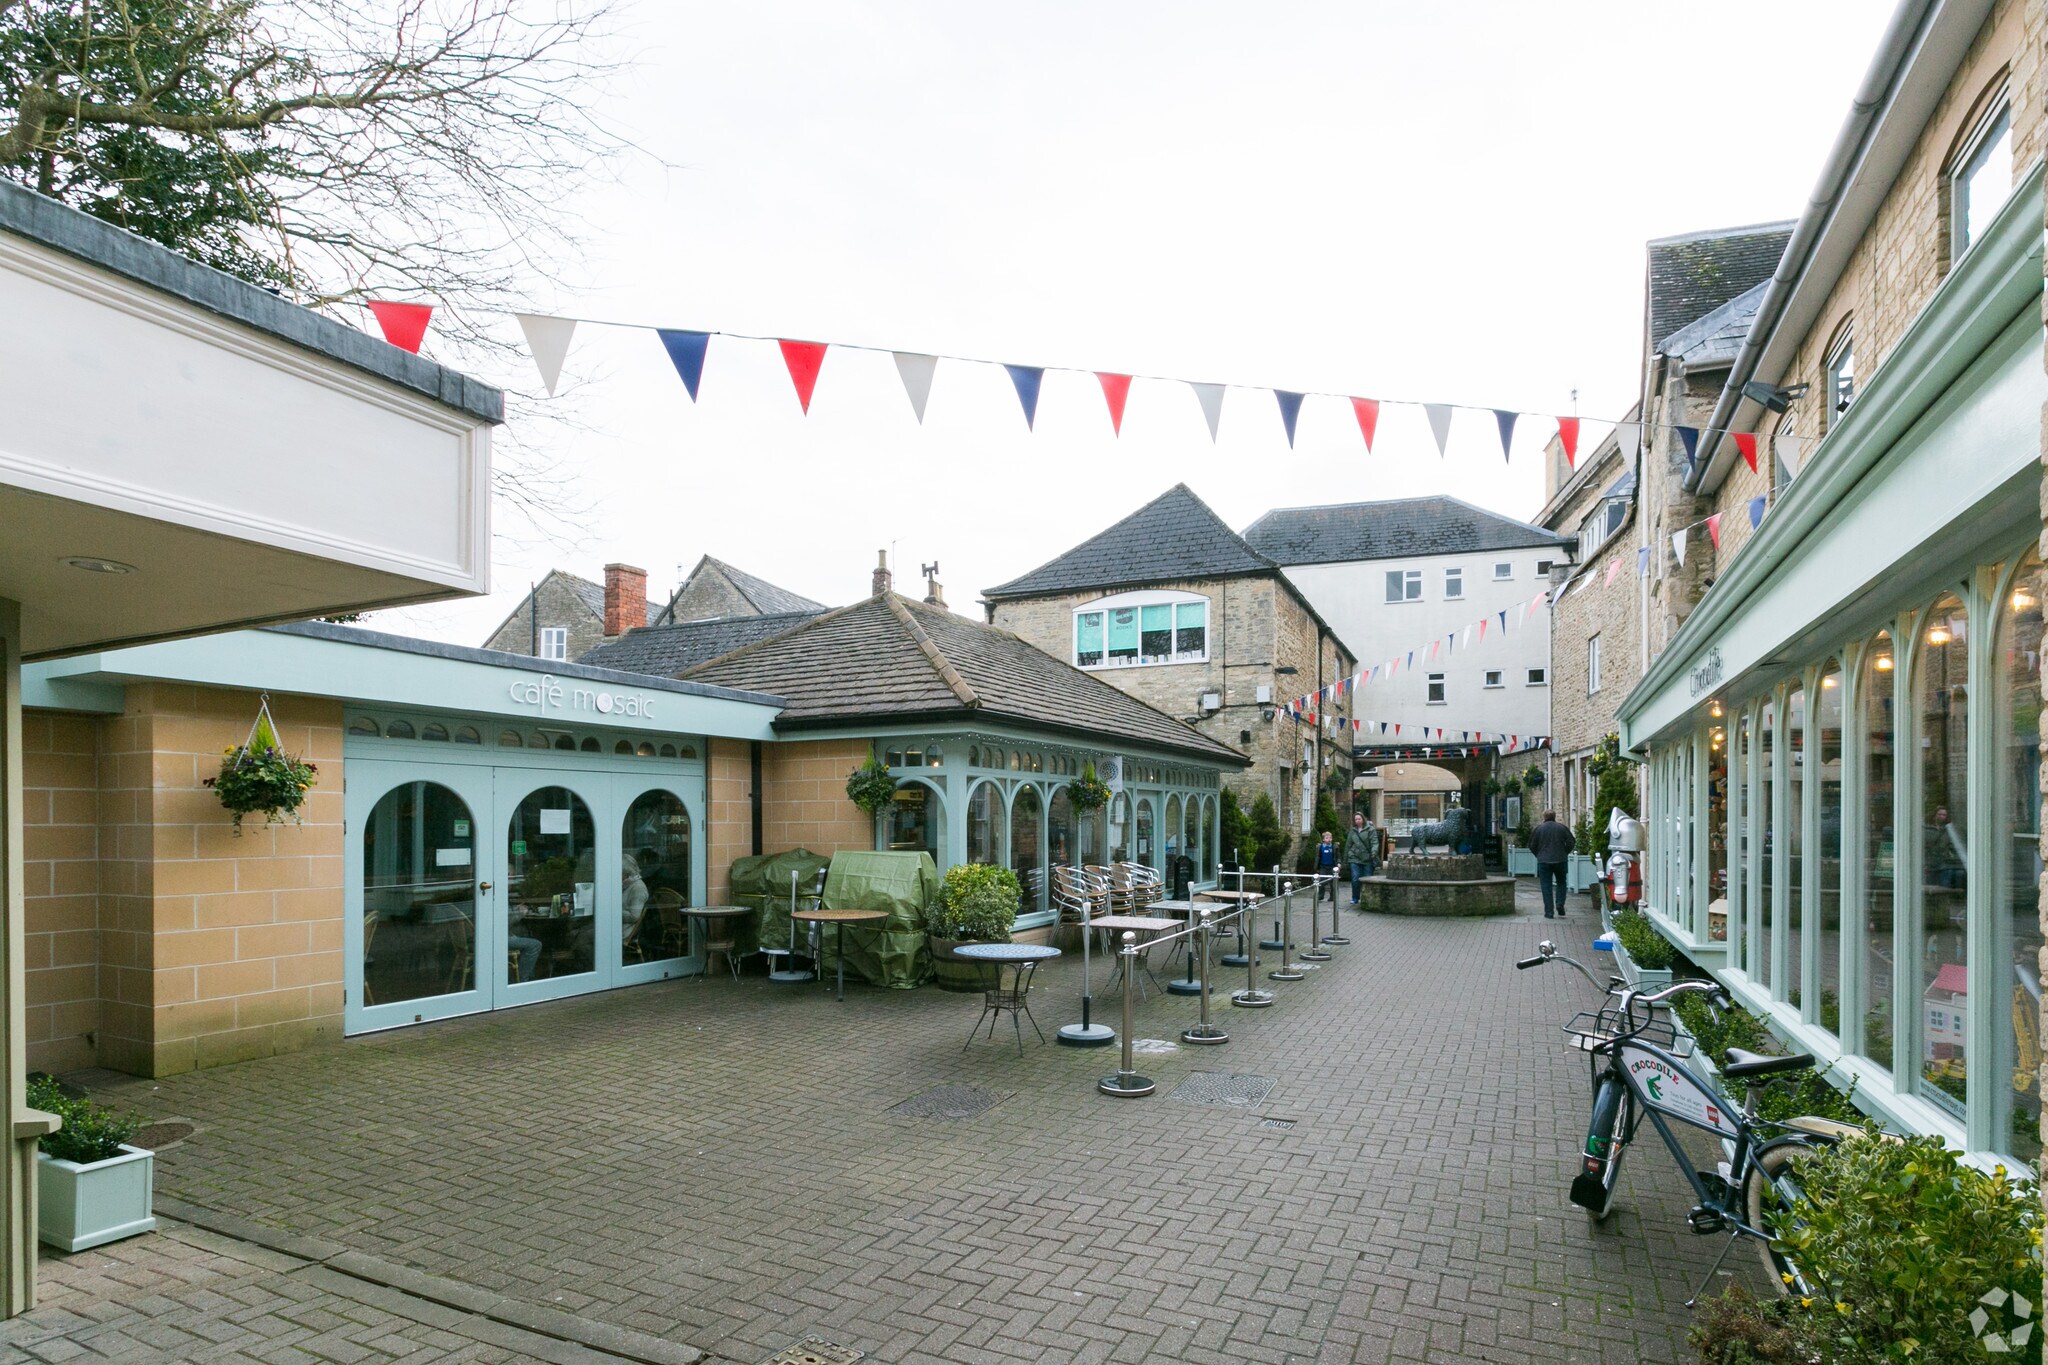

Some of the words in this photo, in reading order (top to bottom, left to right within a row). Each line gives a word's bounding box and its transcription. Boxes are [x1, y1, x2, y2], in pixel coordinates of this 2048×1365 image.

[510, 674, 563, 714] café
[573, 689, 655, 719] mosaic
[1631, 1059, 1680, 1085] CROCODILE
